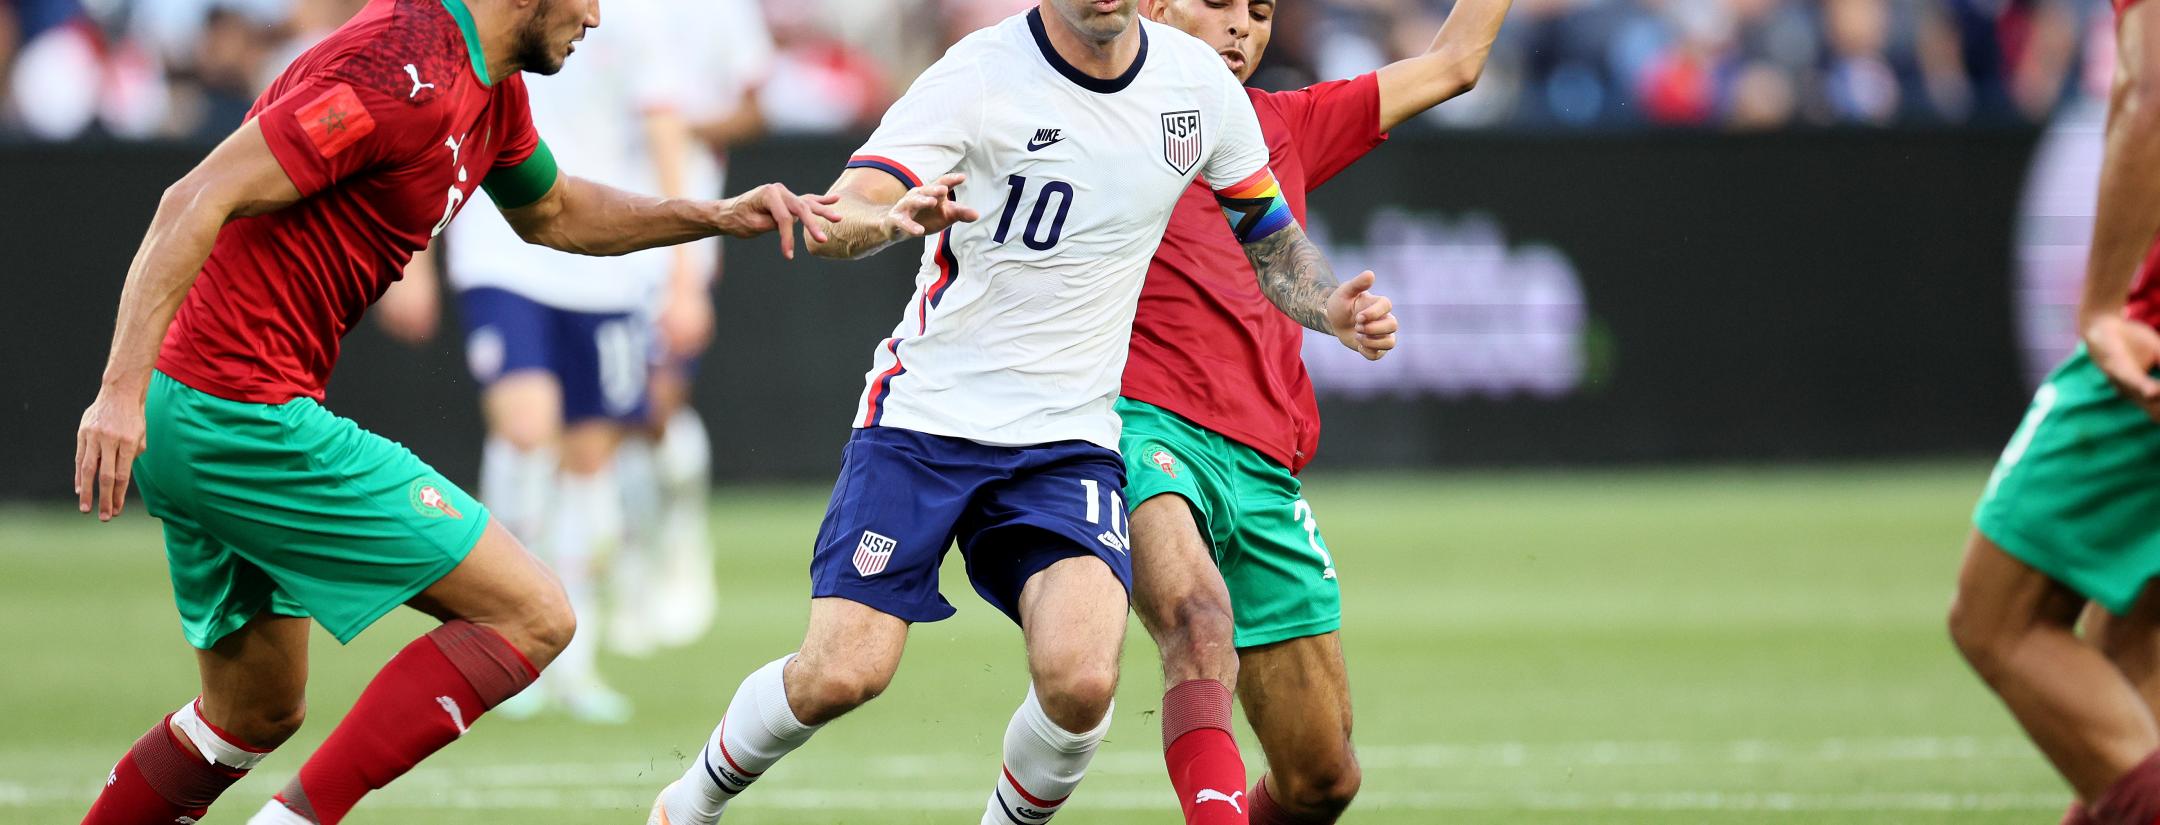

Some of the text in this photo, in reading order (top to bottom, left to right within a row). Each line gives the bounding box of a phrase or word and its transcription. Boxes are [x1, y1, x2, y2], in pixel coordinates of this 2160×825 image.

[1033, 128, 1061, 141] NIKE
[1166, 115, 1197, 138] USA
[993, 174, 1073, 251] 10
[1080, 479, 1130, 550] 10
[863, 534, 894, 553] USA
